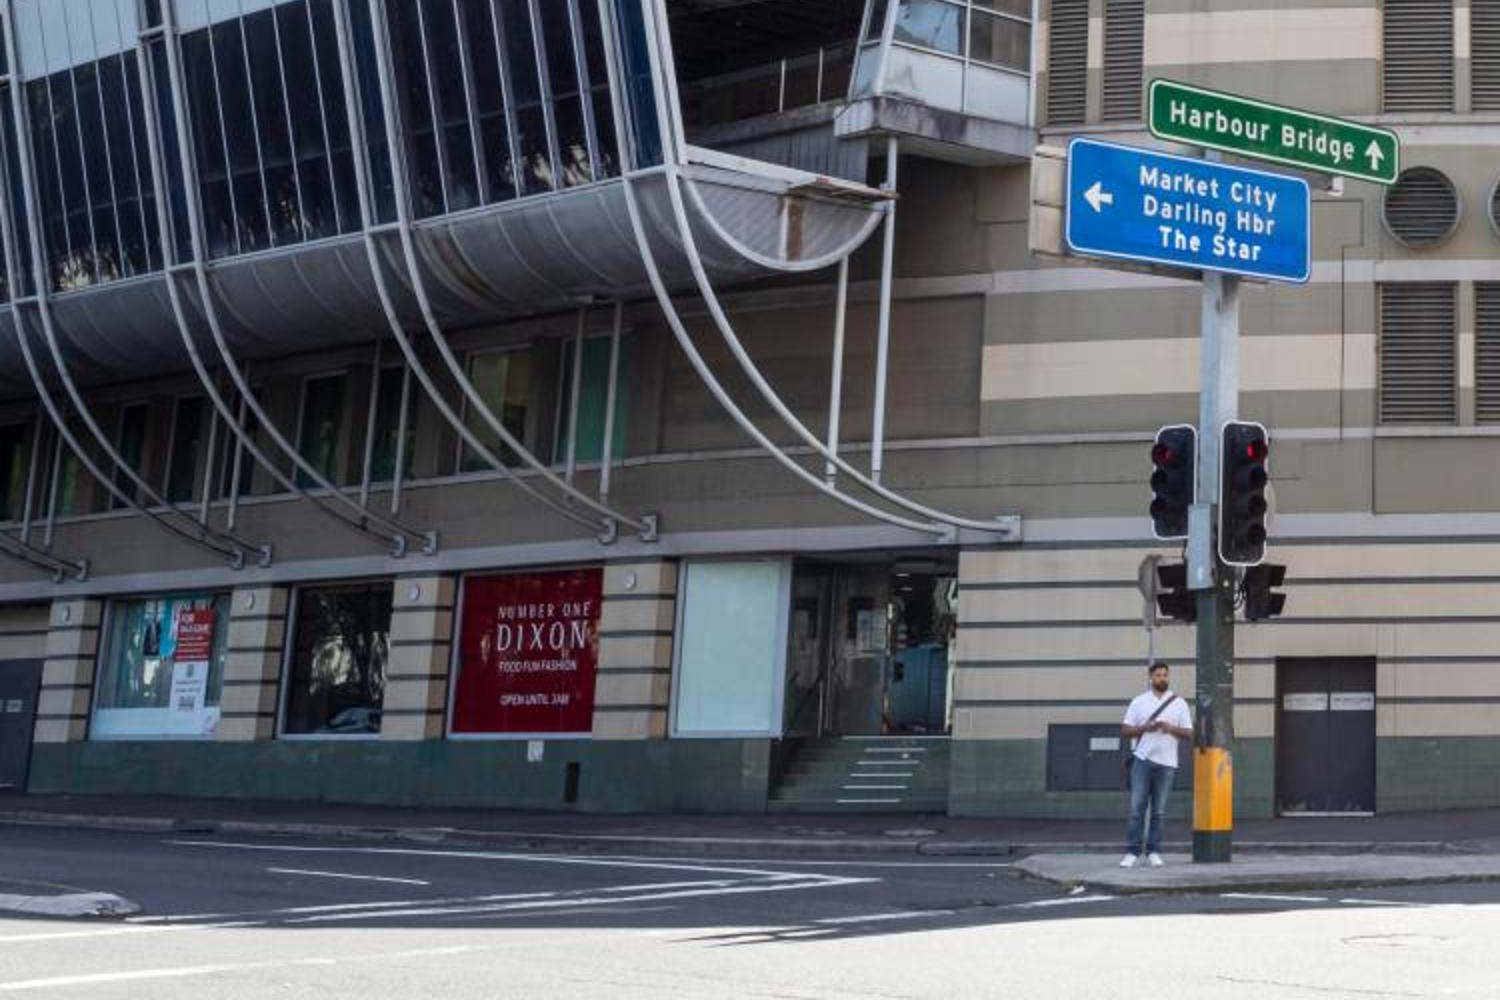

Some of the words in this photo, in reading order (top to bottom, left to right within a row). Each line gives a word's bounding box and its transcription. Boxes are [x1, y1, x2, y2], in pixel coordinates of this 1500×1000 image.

[1169, 99, 1271, 141] Harbour
[1281, 124, 1355, 164] Bridge
[1139, 164, 1219, 199] Market
[1231, 181, 1277, 213] City
[1143, 193, 1228, 234] Darling
[1236, 209, 1276, 236] Hbr
[1158, 224, 1201, 252] The
[1212, 234, 1262, 262] Star
[498, 603, 555, 619] NUMBER
[562, 601, 592, 617] ONE
[496, 620, 588, 652] DIXON
[500, 661, 522, 673] FOOD
[523, 661, 540, 672] FUN
[542, 659, 577, 671] FASHION
[500, 694, 523, 707] OPEN
[524, 693, 548, 706] UNTIL
